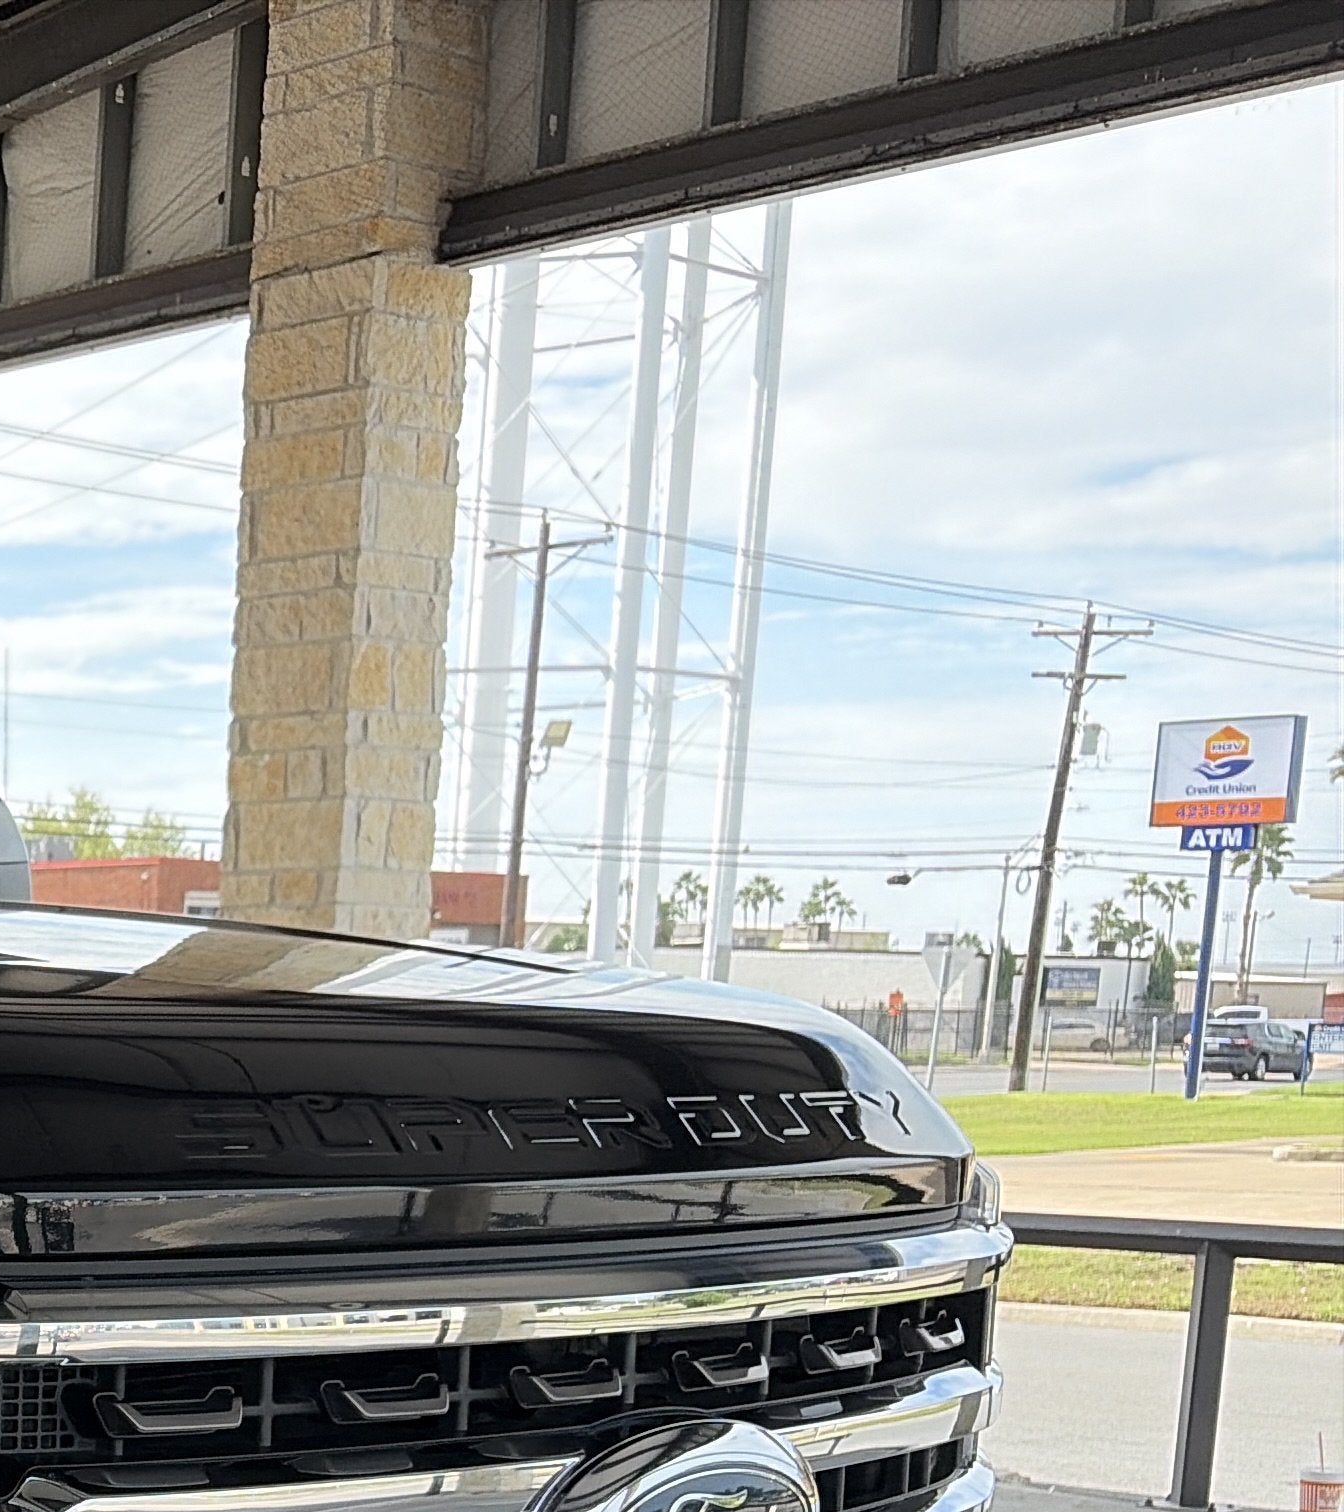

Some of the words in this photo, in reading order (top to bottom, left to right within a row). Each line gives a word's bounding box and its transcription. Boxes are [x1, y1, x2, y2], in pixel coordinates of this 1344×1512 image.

[1185, 784, 1219, 797] Credit
[1223, 782, 1257, 795] Union
[1188, 827, 1243, 848] ATM
[172, 1096, 673, 1160] SUPER
[665, 1090, 911, 1147] DUTY
